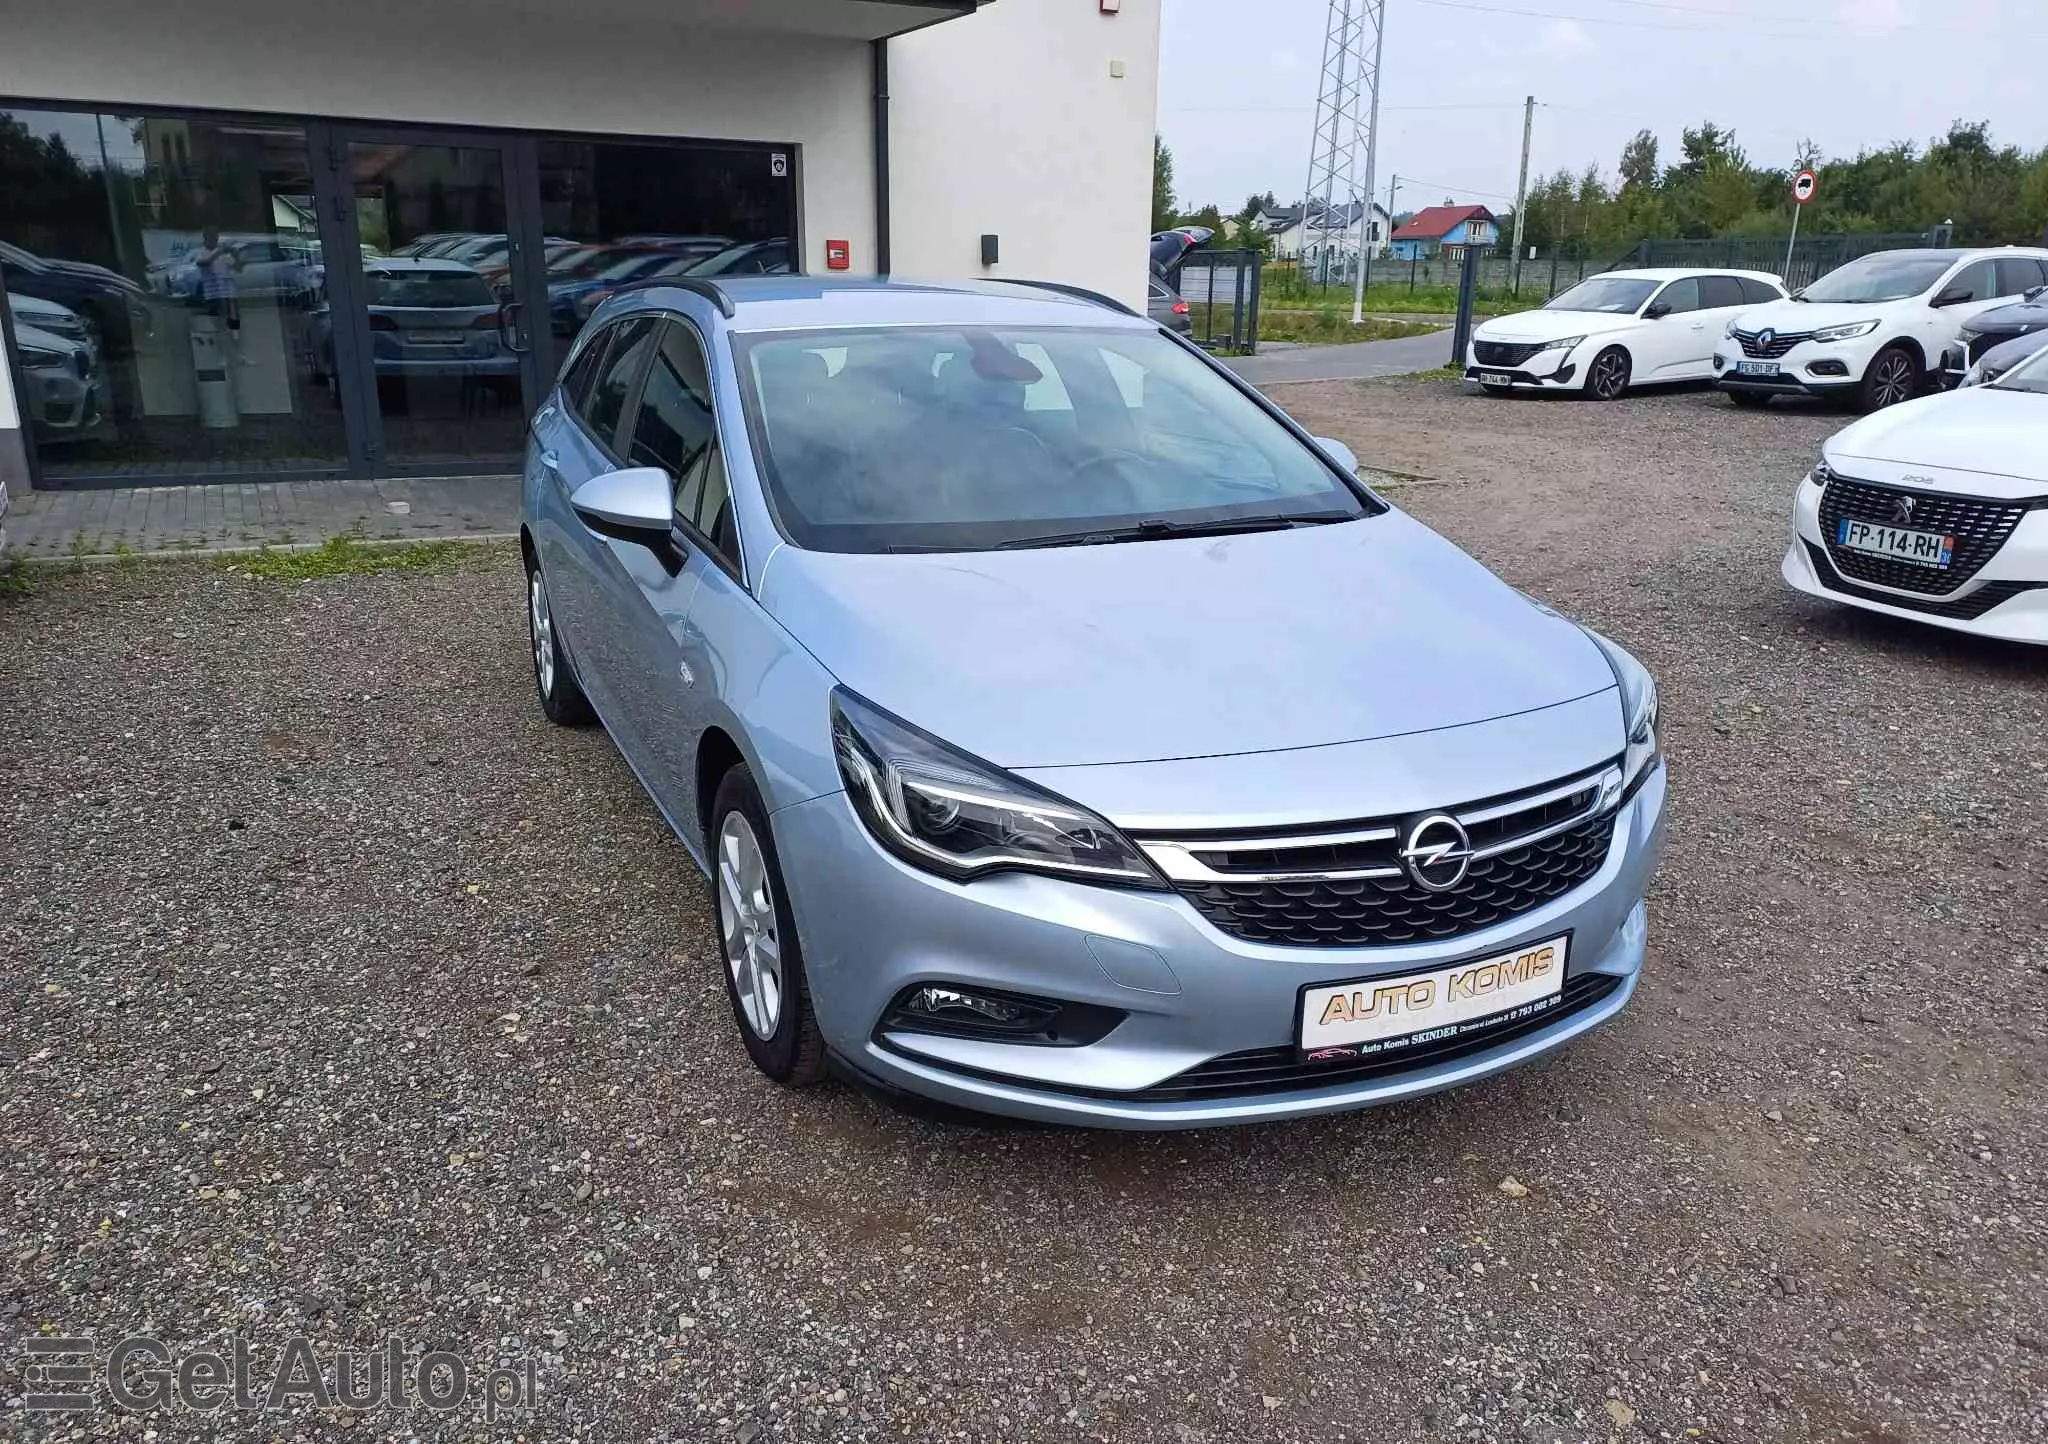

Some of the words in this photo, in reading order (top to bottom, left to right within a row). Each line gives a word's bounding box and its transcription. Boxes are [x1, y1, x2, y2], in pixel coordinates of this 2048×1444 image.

[1319, 980, 1436, 1026] AUTO
[1447, 946, 1555, 1003] KOMIS
[1361, 1045, 1382, 1055] Auto
[1383, 1038, 1410, 1050] Komis
[1411, 1025, 1458, 1045] SKINDER
